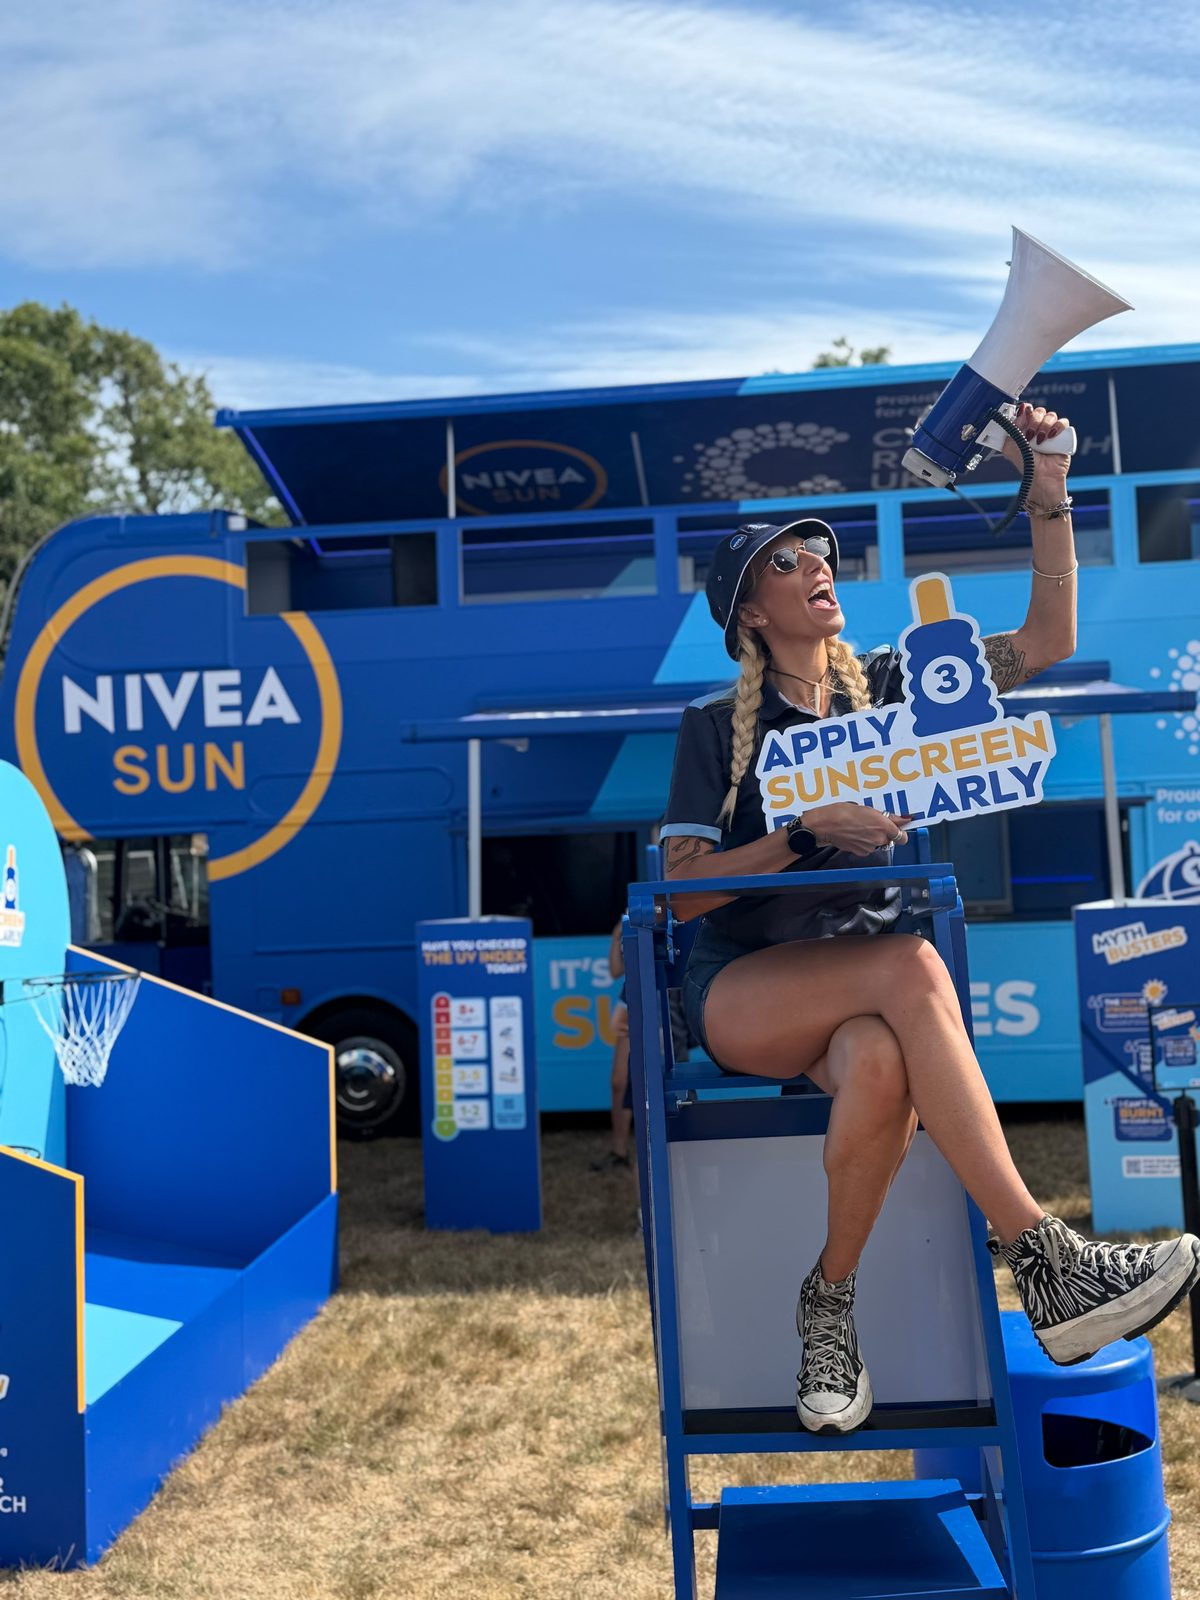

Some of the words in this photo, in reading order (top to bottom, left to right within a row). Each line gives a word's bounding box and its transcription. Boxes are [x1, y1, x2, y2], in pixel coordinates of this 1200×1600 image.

[875, 391, 940, 406] Proud
[461, 466, 586, 490] NIVEA
[491, 486, 561, 504] SUN
[937, 665, 960, 694] 3
[62, 667, 301, 734] NIVEA
[763, 711, 898, 772] APPLY
[113, 741, 245, 795] SUN
[767, 719, 1049, 809] SUNSCREEN
[1156, 788, 1200, 804] Prou
[1157, 807, 1183, 824] for
[421, 941, 450, 952] HAVE
[451, 940, 475, 951] YOU
[476, 938, 527, 950] CHECKED
[1096, 926, 1145, 950] MYTH
[1108, 930, 1185, 961] BUSTERS
[423, 951, 452, 966] THE
[454, 951, 477, 965] UV
[479, 949, 526, 964] INDEX
[486, 963, 528, 974] TODAY?
[549, 956, 613, 990] IT'S
[457, 1035, 479, 1046] 6-7
